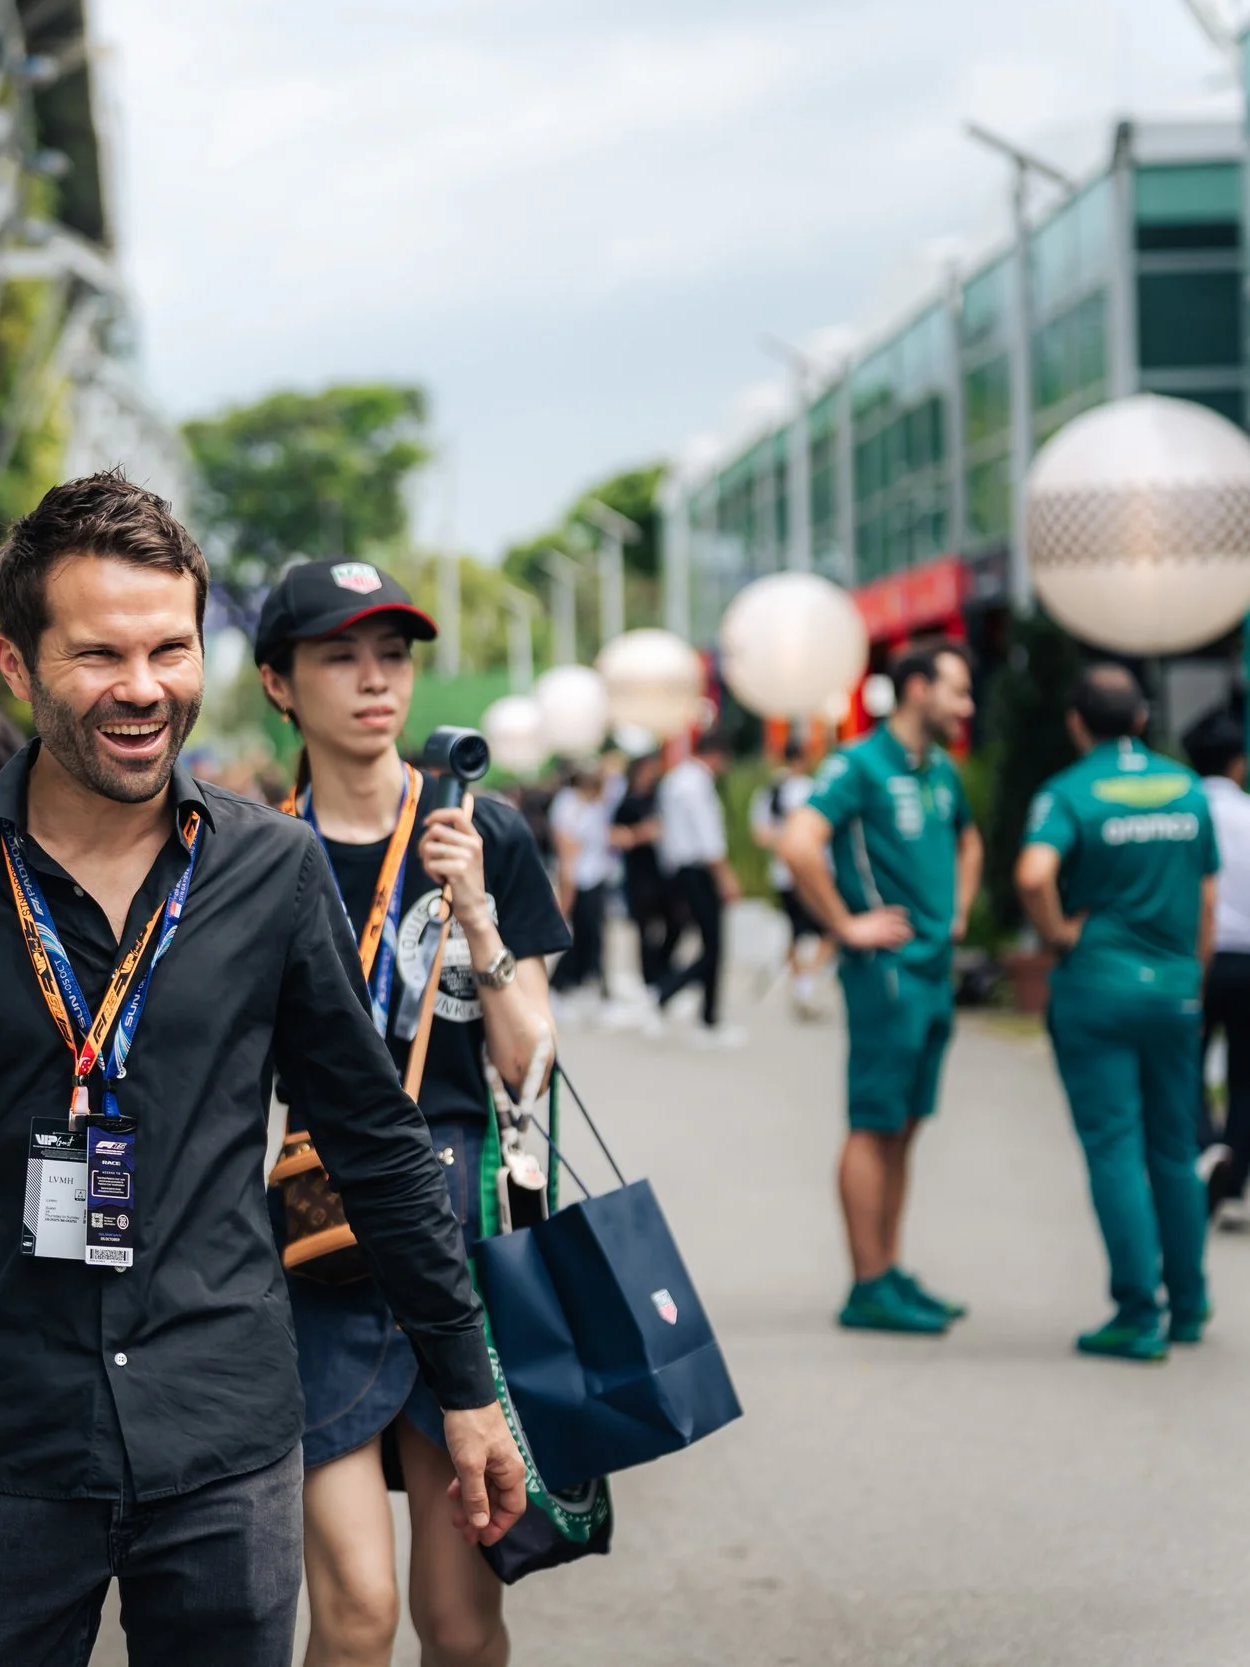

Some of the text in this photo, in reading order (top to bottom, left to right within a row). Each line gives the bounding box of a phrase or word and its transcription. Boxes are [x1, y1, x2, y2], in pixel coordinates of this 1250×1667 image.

[69, 995, 87, 1029] SUN
[124, 993, 141, 1027] SUN
[35, 1134, 57, 1145] VIP
[49, 1176, 73, 1184] LVMH
